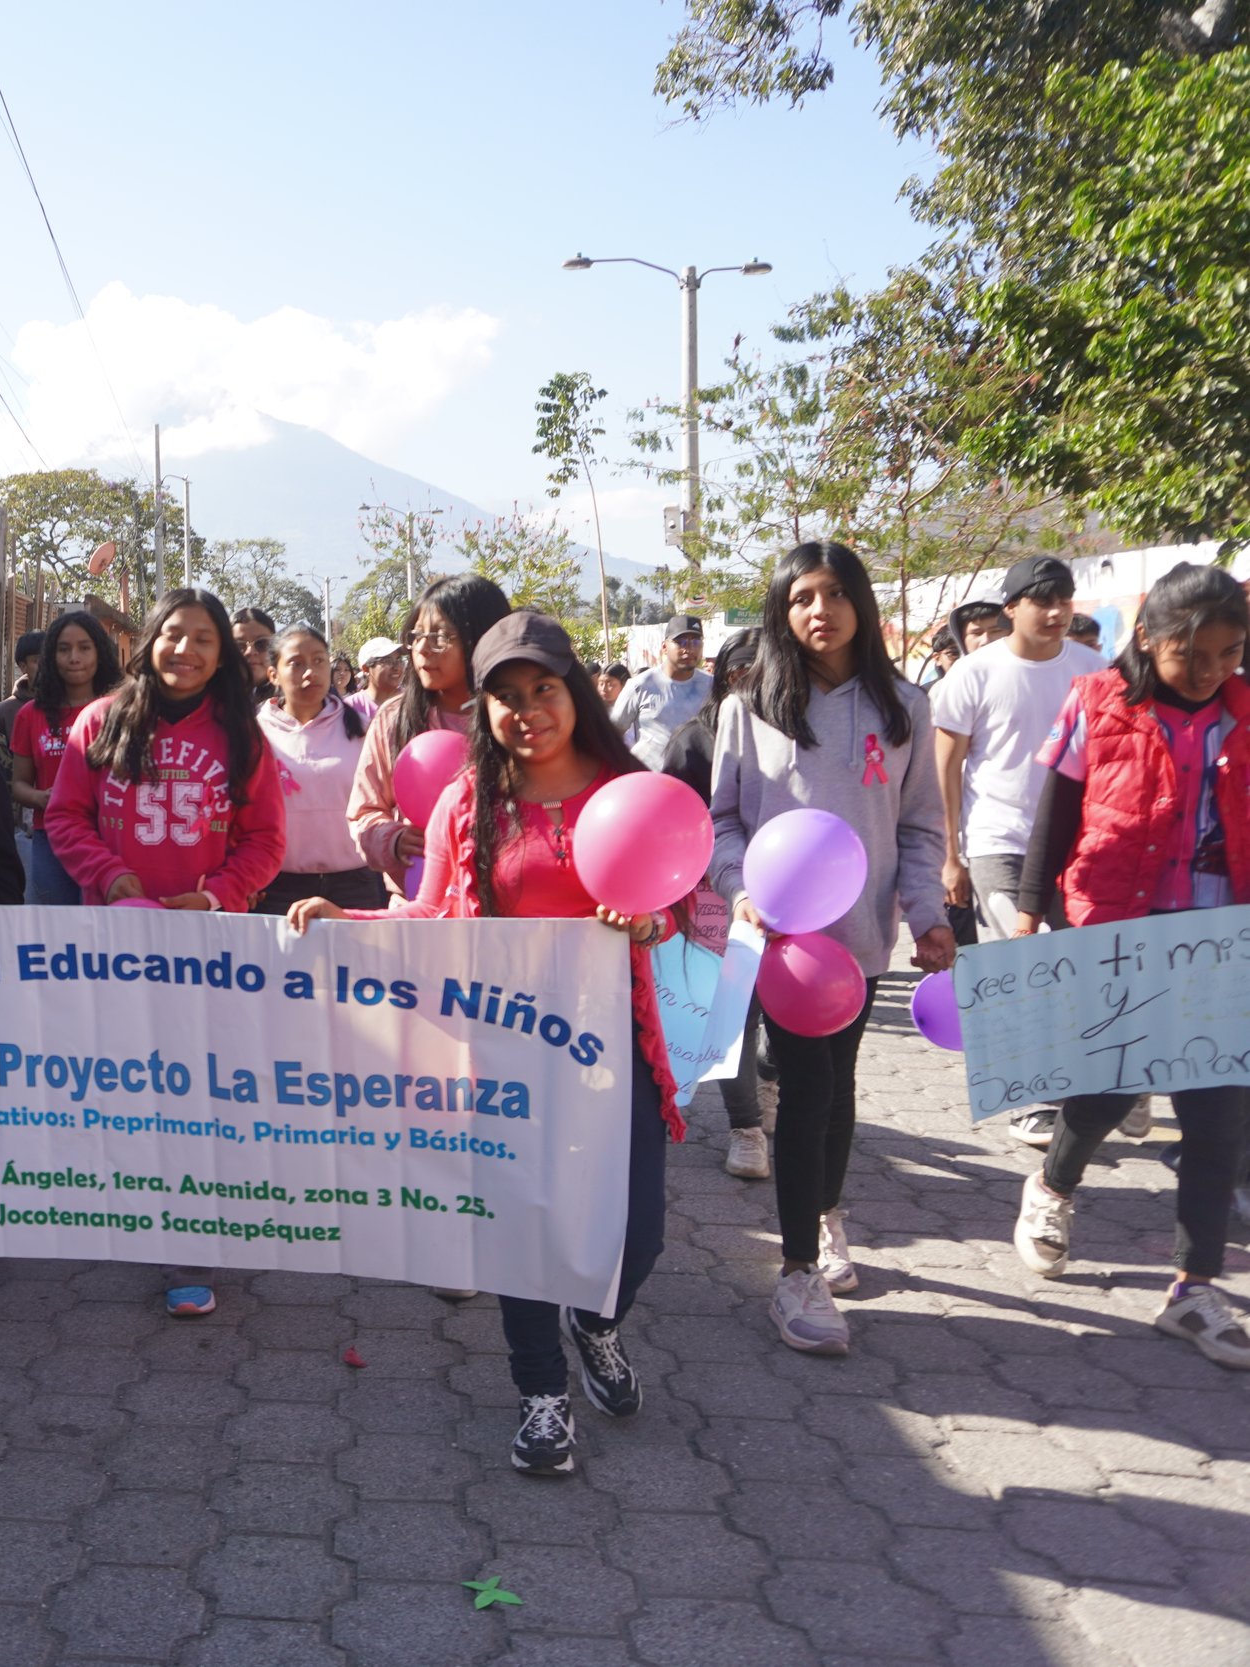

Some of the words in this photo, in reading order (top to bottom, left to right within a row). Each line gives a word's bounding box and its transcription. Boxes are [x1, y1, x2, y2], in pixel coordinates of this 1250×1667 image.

[135, 781, 204, 847] 55
[1027, 957, 1076, 988] en
[1098, 933, 1147, 977] ti
[17, 943, 265, 993] Educando
[284, 967, 314, 1000] a
[336, 965, 418, 1010] los
[441, 977, 605, 1067] Niños
[207, 1053, 259, 1103] La
[274, 1060, 531, 1120] Esperanza
[82, 1108, 246, 1144] Preprimaria,
[253, 1121, 376, 1147] Primaria
[384, 1131, 402, 1151] y
[409, 1127, 517, 1160] Básicos.
[1, 1160, 105, 1190] Ángeles,
[112, 1170, 172, 1193] 1era.
[179, 1174, 296, 1205] Avenida,
[304, 1187, 369, 1206] zona
[377, 1187, 393, 1207] 3
[401, 1185, 448, 1213] No.
[456, 1195, 496, 1219] 25.
[160, 1210, 341, 1242] Sacatepéquez
